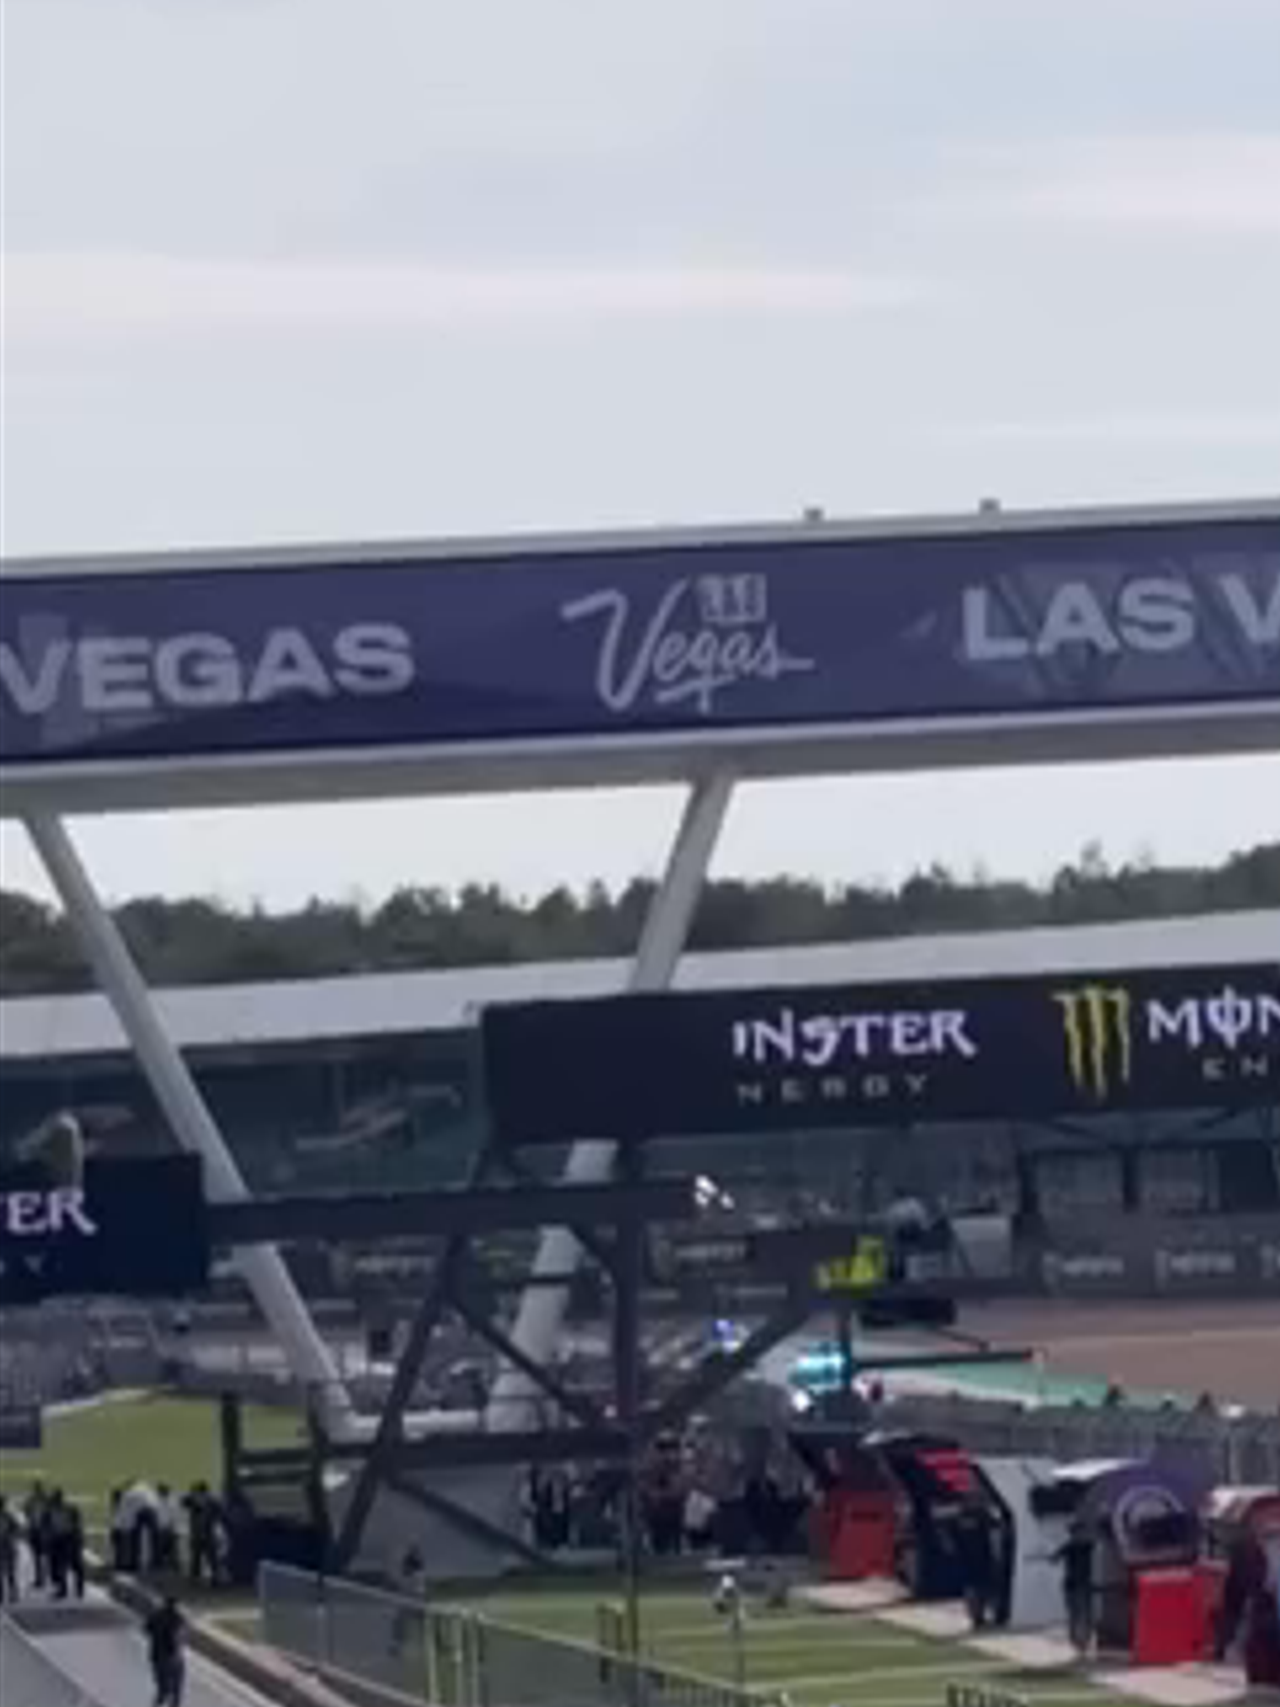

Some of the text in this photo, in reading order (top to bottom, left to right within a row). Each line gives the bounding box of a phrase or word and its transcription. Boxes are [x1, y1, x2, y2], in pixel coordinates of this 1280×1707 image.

[561, 576, 815, 714] Vegas
[962, 577, 1196, 661] LAS
[0, 623, 415, 714] VEGAS
